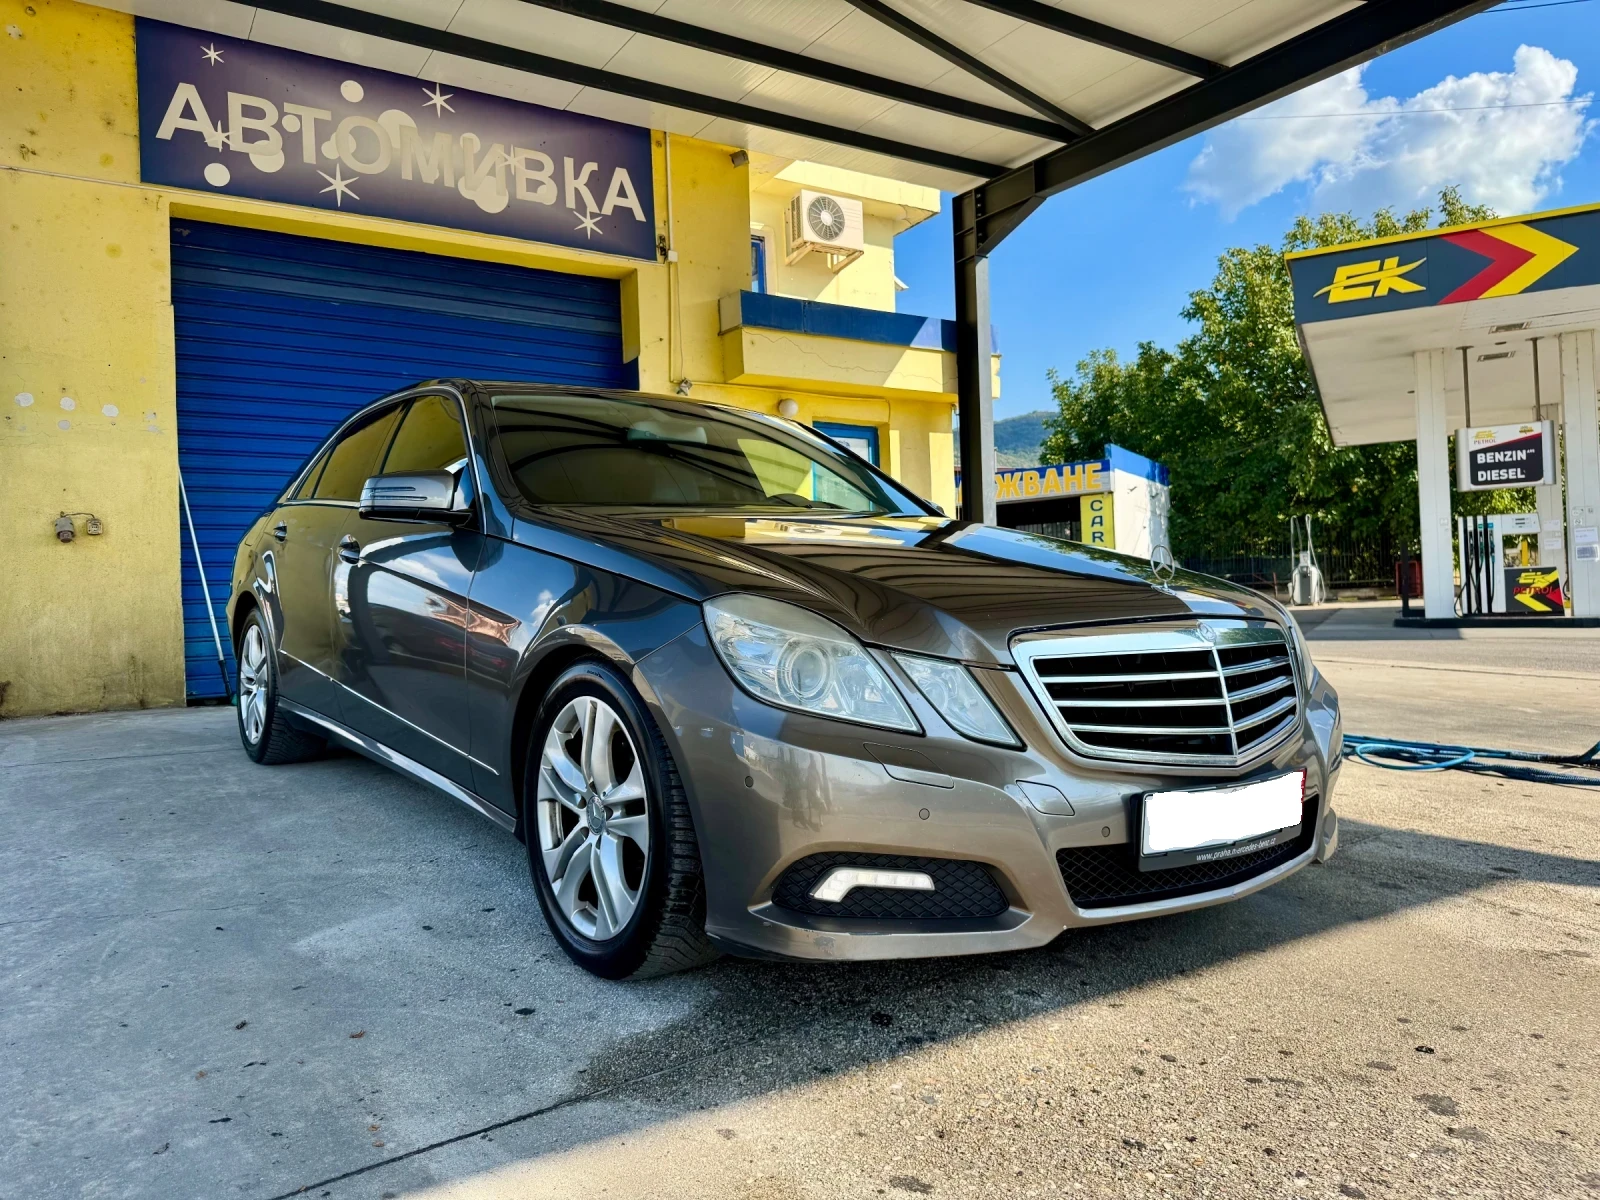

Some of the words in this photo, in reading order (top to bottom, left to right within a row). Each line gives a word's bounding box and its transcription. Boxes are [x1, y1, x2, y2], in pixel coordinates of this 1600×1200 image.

[156, 82, 646, 222] АВТОМИВКА
[1477, 449, 1526, 464] BENZIN
[995, 463, 1102, 498] ЖВАНЕ
[1477, 468, 1526, 482] DIESEL
[1090, 499, 1105, 543] CAR
